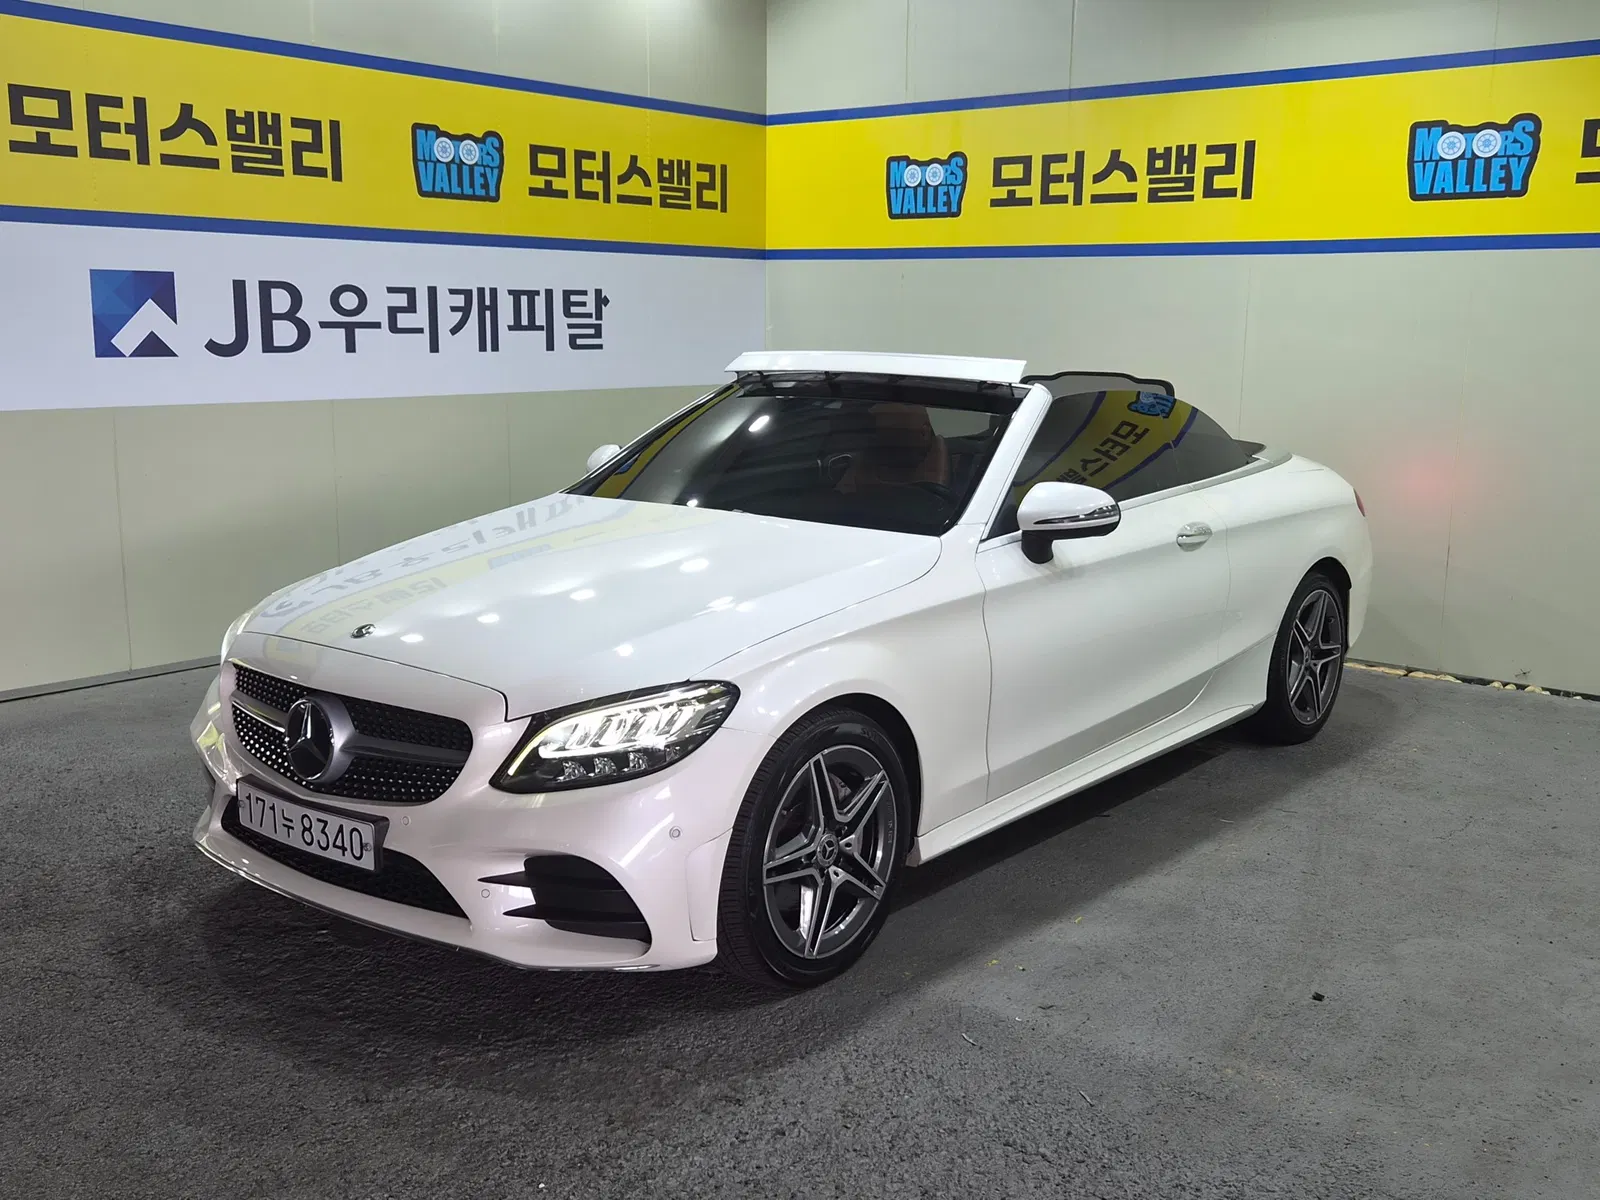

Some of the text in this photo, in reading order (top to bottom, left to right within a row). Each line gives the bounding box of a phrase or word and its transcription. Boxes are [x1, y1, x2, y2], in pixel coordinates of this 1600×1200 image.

[8, 83, 343, 182] 모터스밸리
[417, 161, 499, 197] VALLEY
[528, 144, 728, 213] 모터스밸리
[990, 139, 1256, 207] 모터스밸리
[1414, 156, 1530, 195] VALLEY
[890, 185, 962, 215] VALLEY
